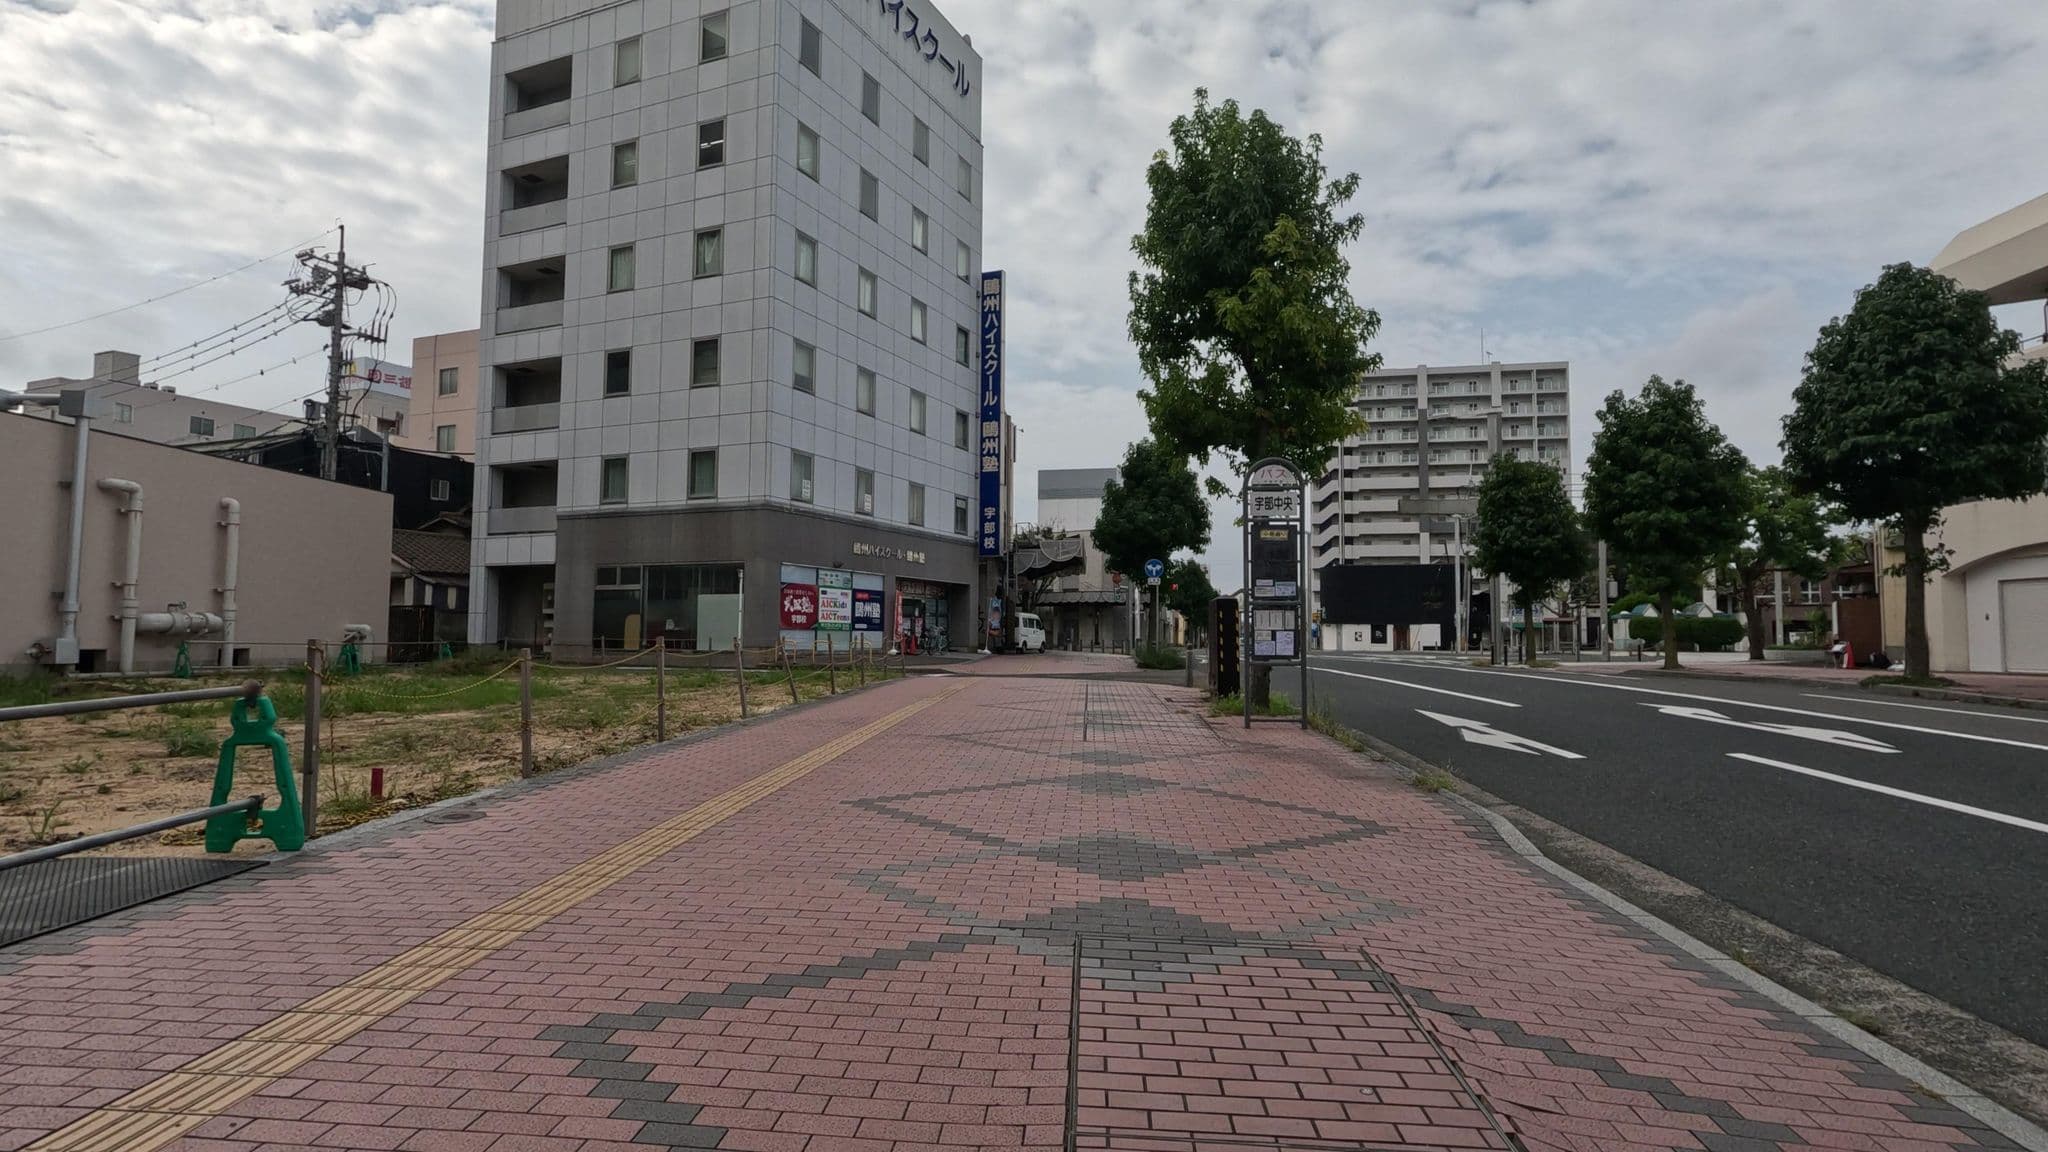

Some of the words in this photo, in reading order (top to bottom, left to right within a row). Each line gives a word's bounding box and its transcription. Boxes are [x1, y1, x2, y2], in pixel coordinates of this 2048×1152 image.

[1261, 468, 1286, 479] バス
[1254, 495, 1293, 511] 宇部中央
[983, 506, 997, 549] 宇部校
